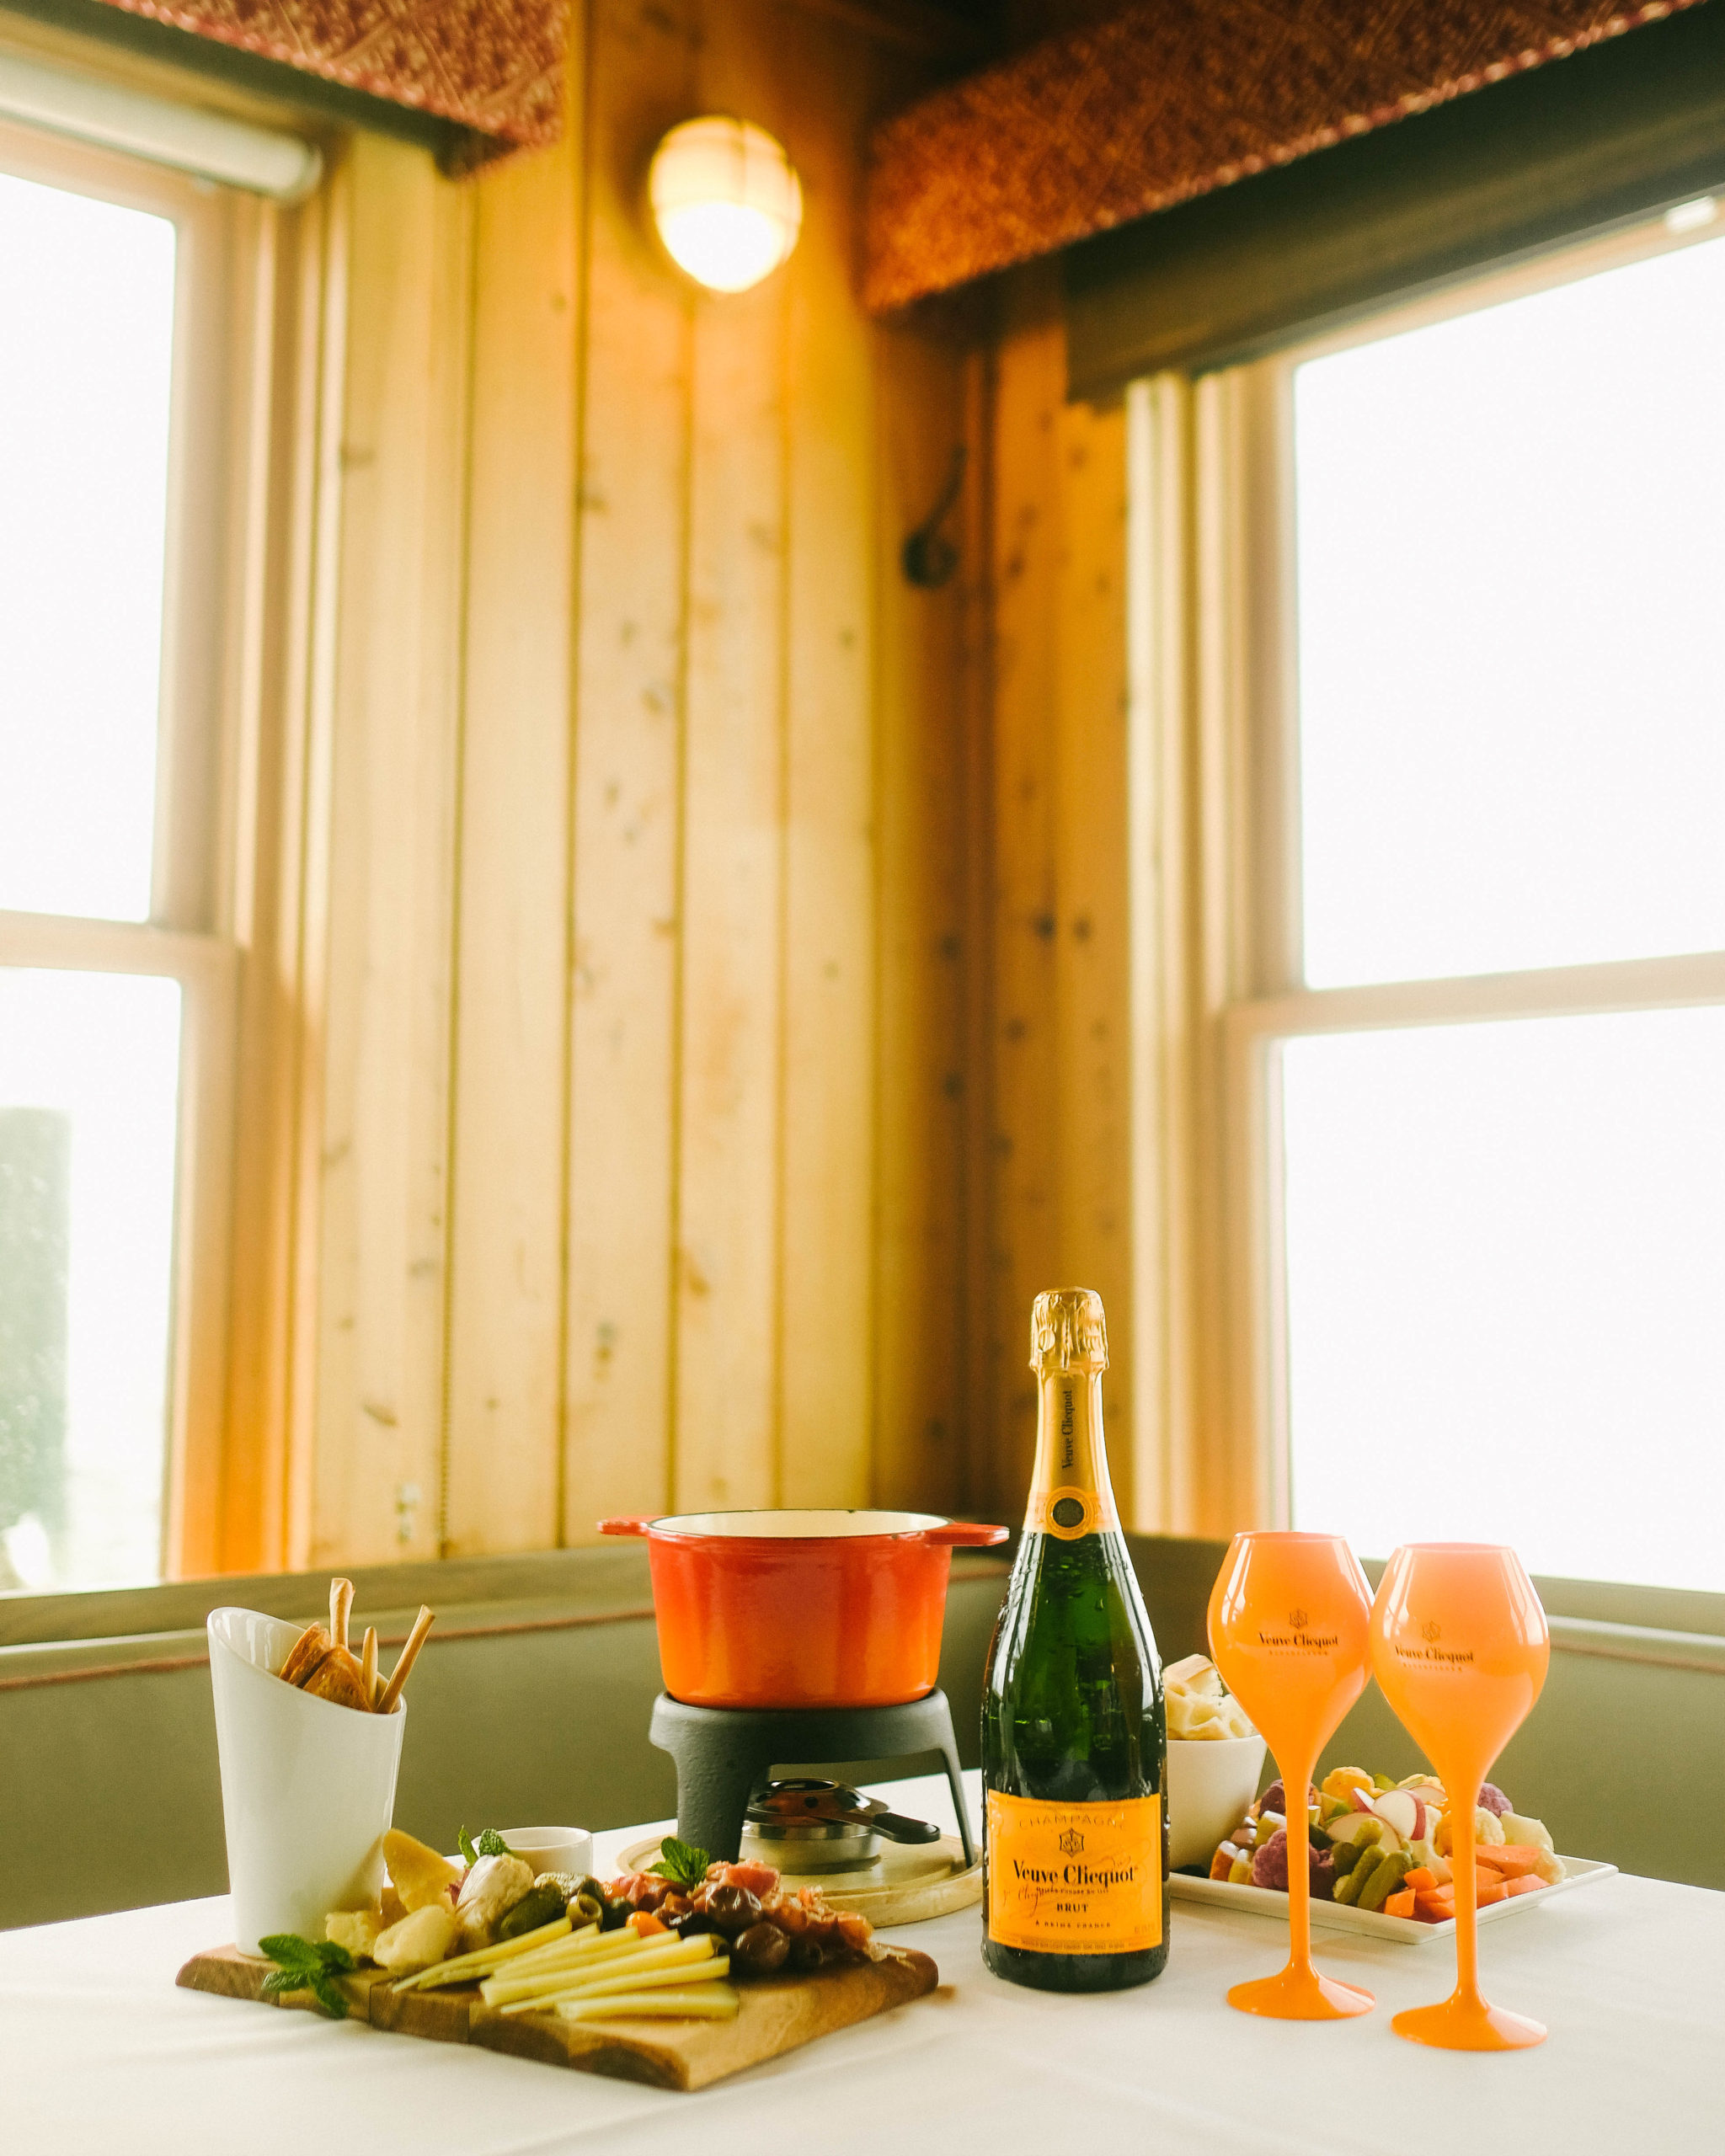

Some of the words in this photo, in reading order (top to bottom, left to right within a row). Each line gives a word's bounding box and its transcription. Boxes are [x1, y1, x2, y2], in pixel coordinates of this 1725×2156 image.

[1061, 1390, 1075, 1435] Clicquot
[1061, 1438, 1073, 1469] Veuve
[1258, 1632, 1290, 1646] Veuve
[1293, 1633, 1338, 1648] Clicquot
[1395, 1645, 1423, 1659] Veuve
[1425, 1646, 1475, 1663] Clicquot
[1013, 1860, 1058, 1882] Veuve
[1063, 1865, 1135, 1887] Clicquot
[1056, 1903, 1088, 1913] BRUT
